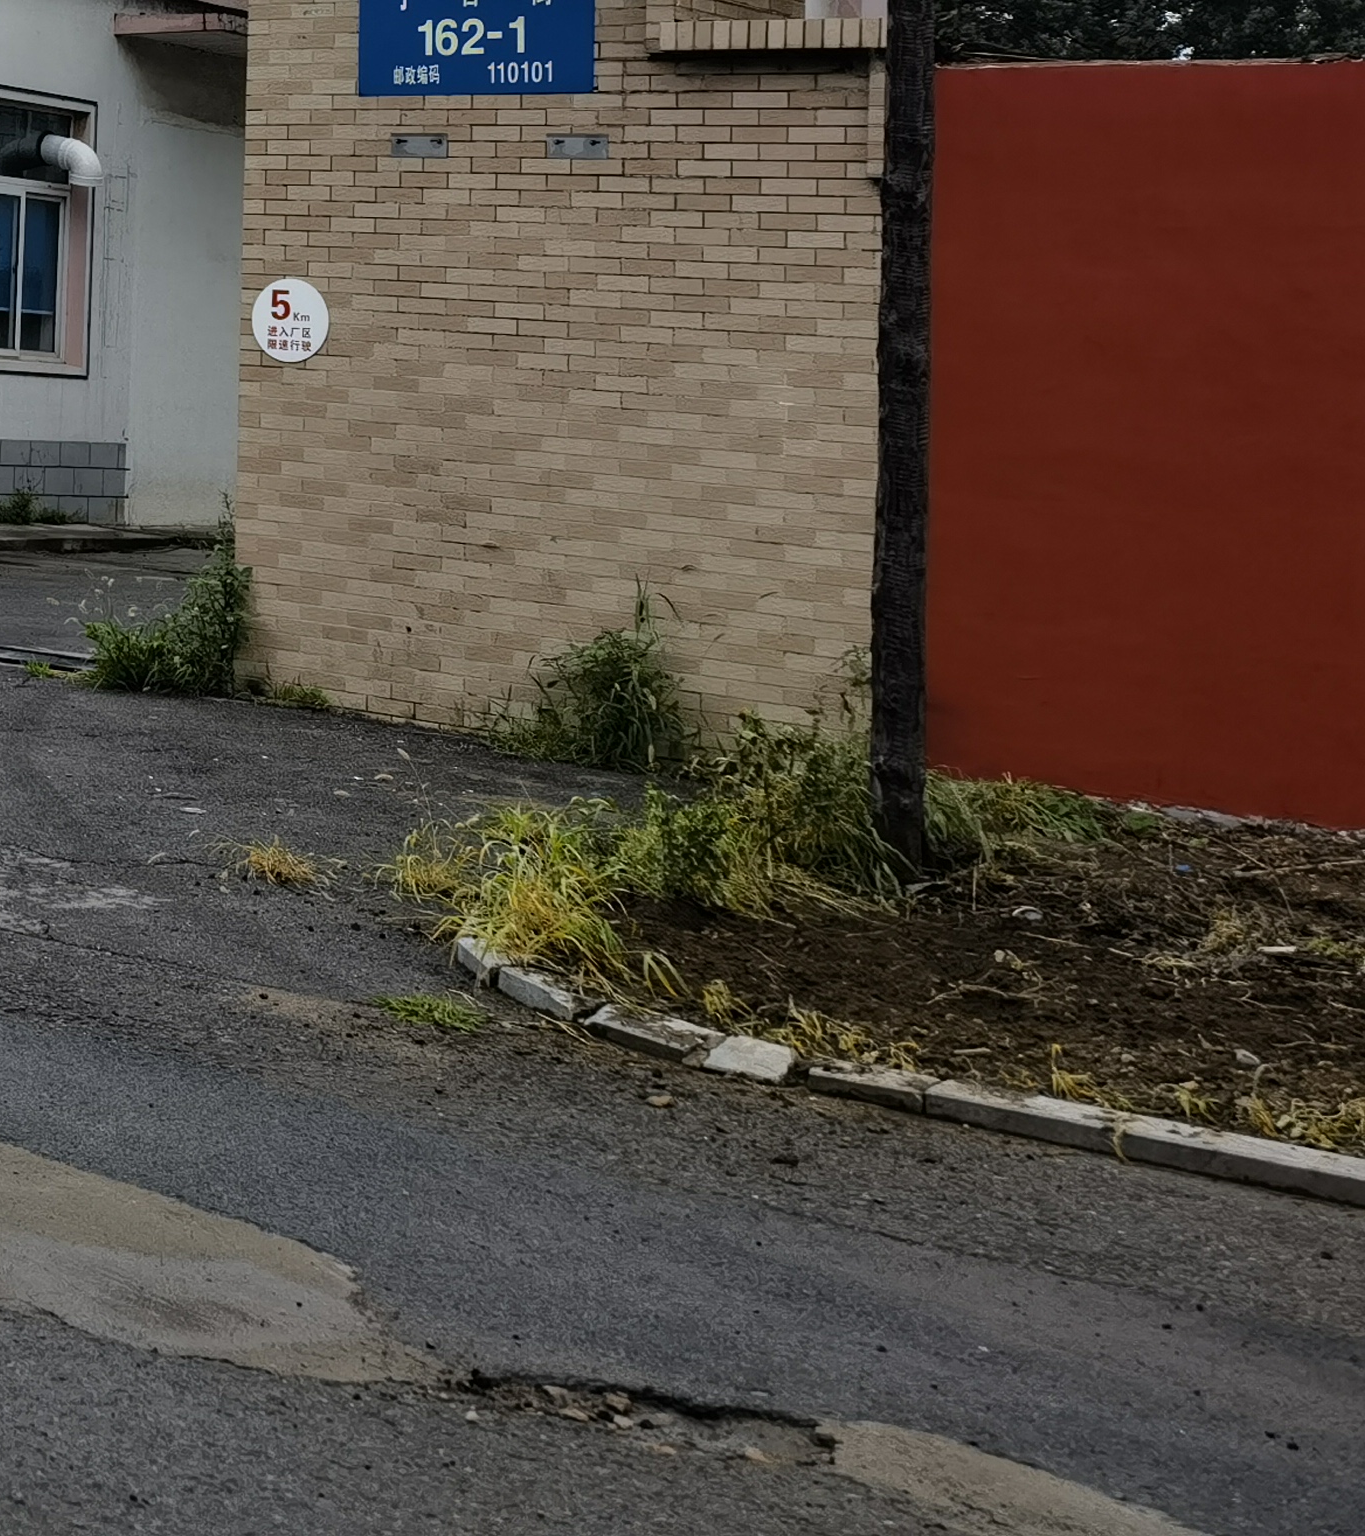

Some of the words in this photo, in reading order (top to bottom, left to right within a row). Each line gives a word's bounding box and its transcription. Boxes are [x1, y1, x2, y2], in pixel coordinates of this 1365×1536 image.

[417, 16, 526, 57] 162-1
[393, 64, 440, 85] 邮政编码
[487, 61, 554, 84] 110101
[271, 289, 291, 320] 5
[293, 312, 311, 322] Km
[267, 325, 311, 339] 进入厂区
[267, 339, 312, 352] 限速行驶
